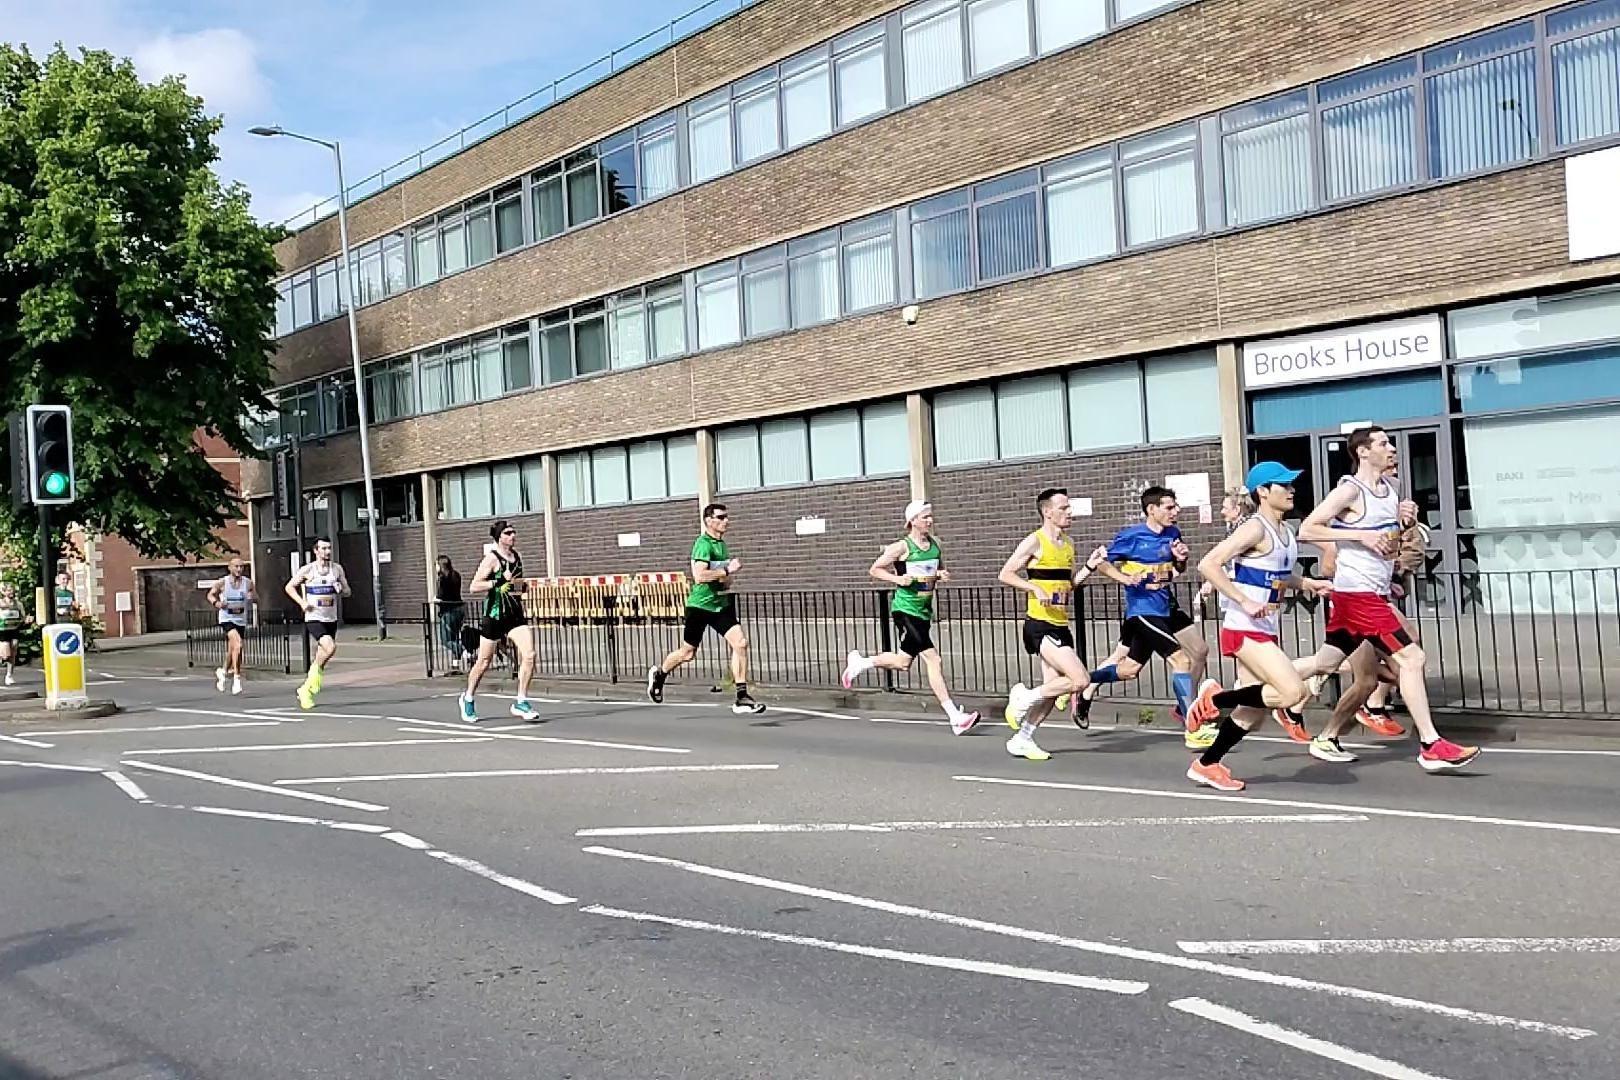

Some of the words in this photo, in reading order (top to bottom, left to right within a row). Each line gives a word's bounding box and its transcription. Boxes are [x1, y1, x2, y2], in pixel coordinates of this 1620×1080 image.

[1254, 346, 1336, 376] Brooks
[1345, 335, 1429, 363] House
[1496, 471, 1524, 482] BAXI
